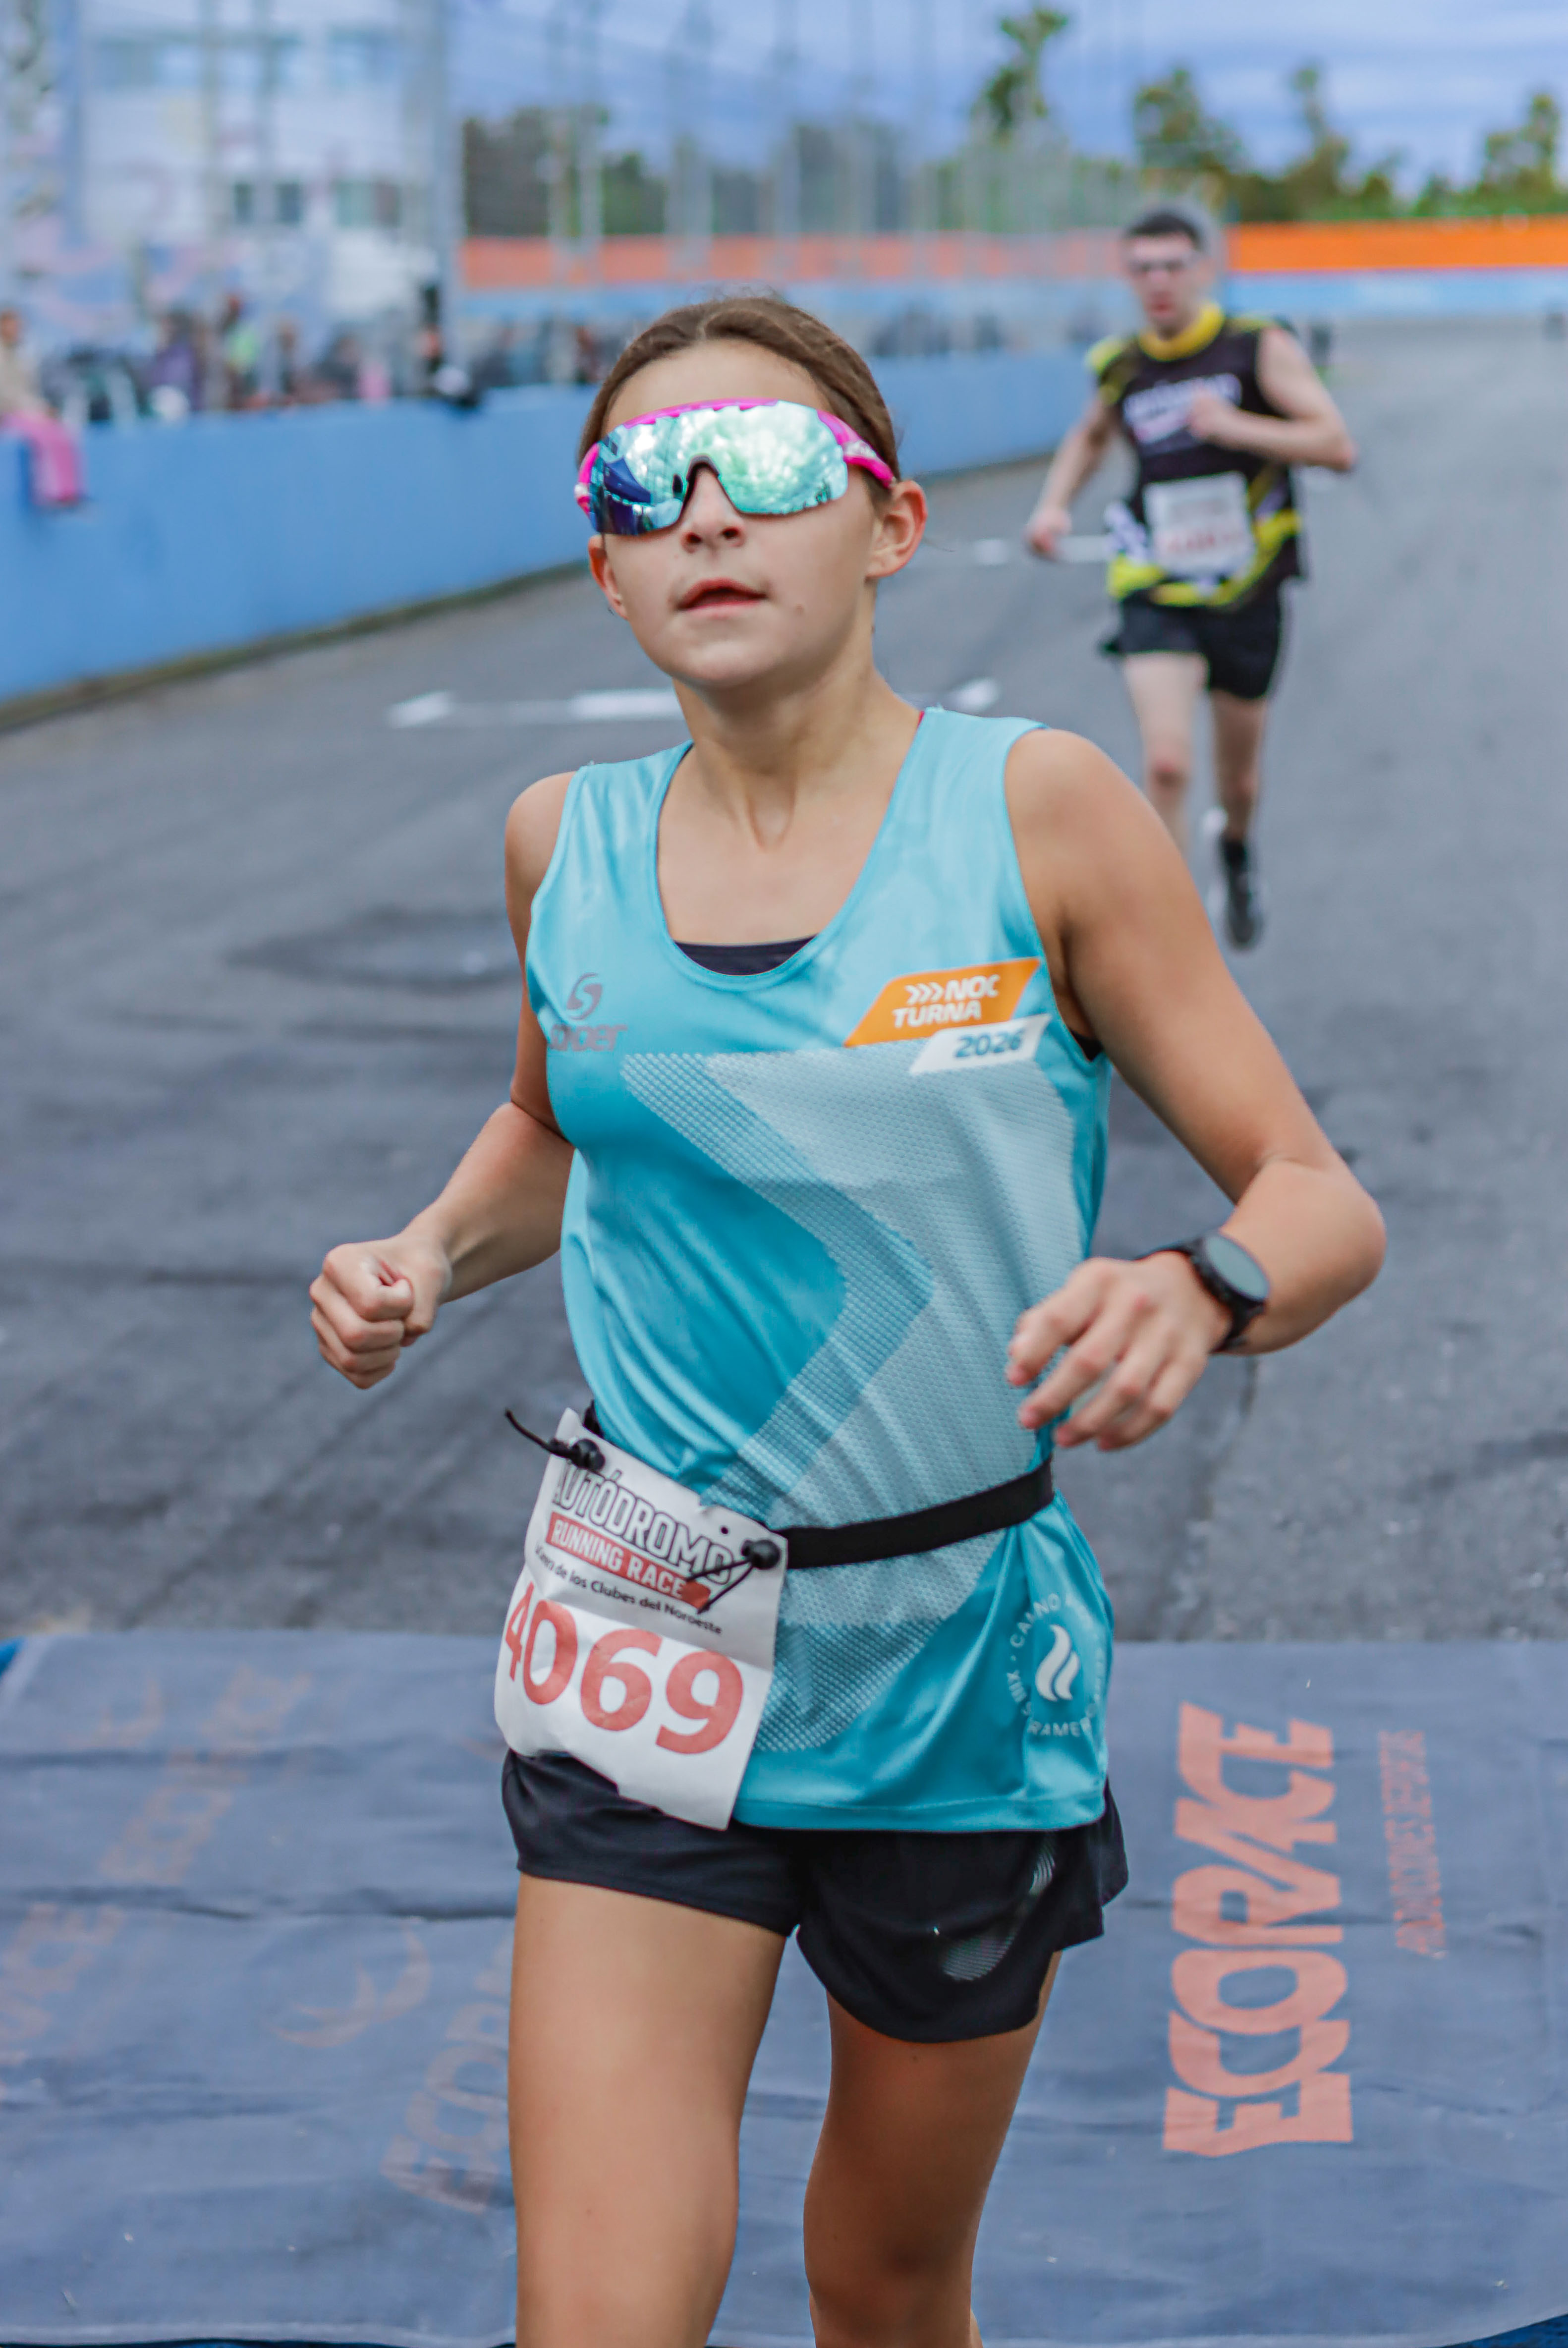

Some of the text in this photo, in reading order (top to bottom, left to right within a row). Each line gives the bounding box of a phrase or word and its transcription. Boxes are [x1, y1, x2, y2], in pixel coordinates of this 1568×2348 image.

[892, 1000, 982, 1029] TURNA
[945, 974, 1001, 1002] NOC
[954, 1028, 1027, 1058] 2026
[551, 1518, 624, 1571] RUNNING
[626, 1555, 687, 1599] RACE
[569, 1569, 587, 1588] los
[591, 1580, 635, 1604] Clubes
[639, 1597, 661, 1611] del
[665, 1603, 722, 1634] Noroeste
[504, 1582, 743, 1755] 4069
[1162, 1700, 1354, 2158] ECORACE
